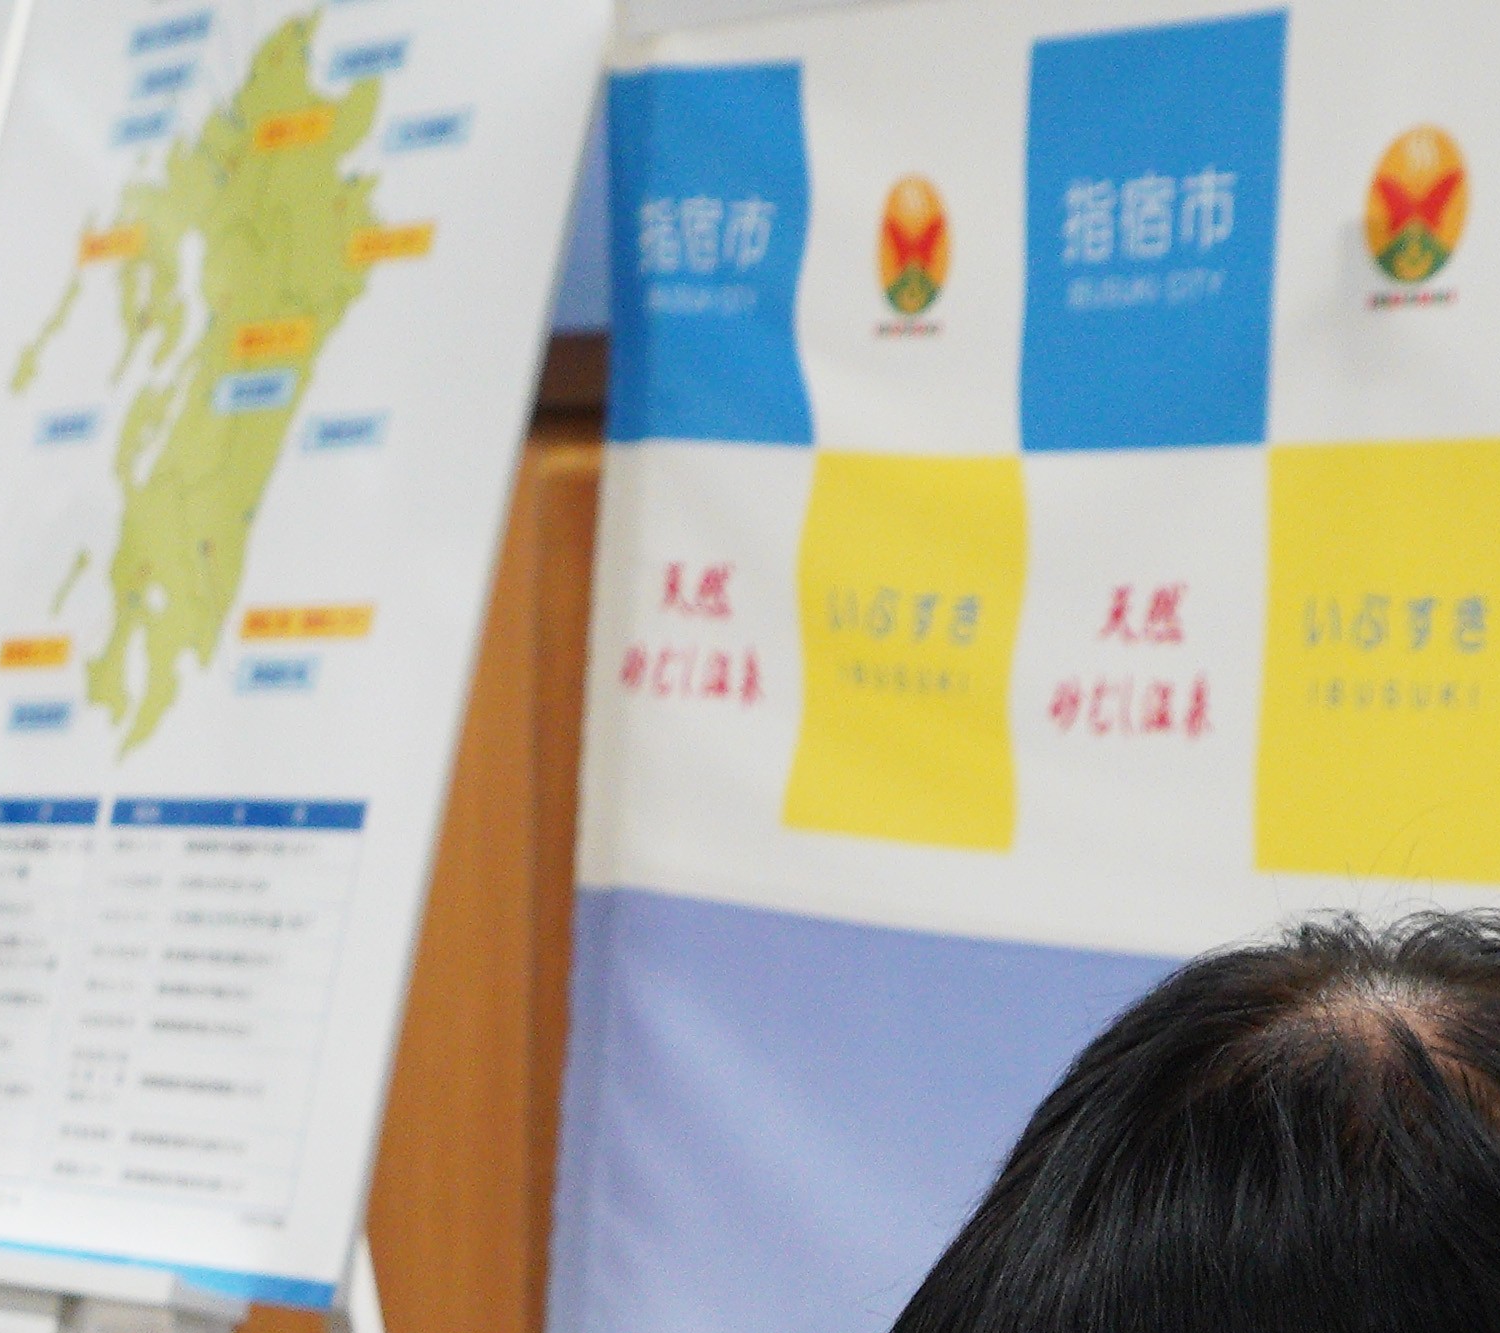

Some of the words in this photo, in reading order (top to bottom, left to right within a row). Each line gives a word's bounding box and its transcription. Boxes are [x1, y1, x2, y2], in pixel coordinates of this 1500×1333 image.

[1062, 166, 1237, 264] 指宿市
[1304, 591, 1490, 654] いぶすき
